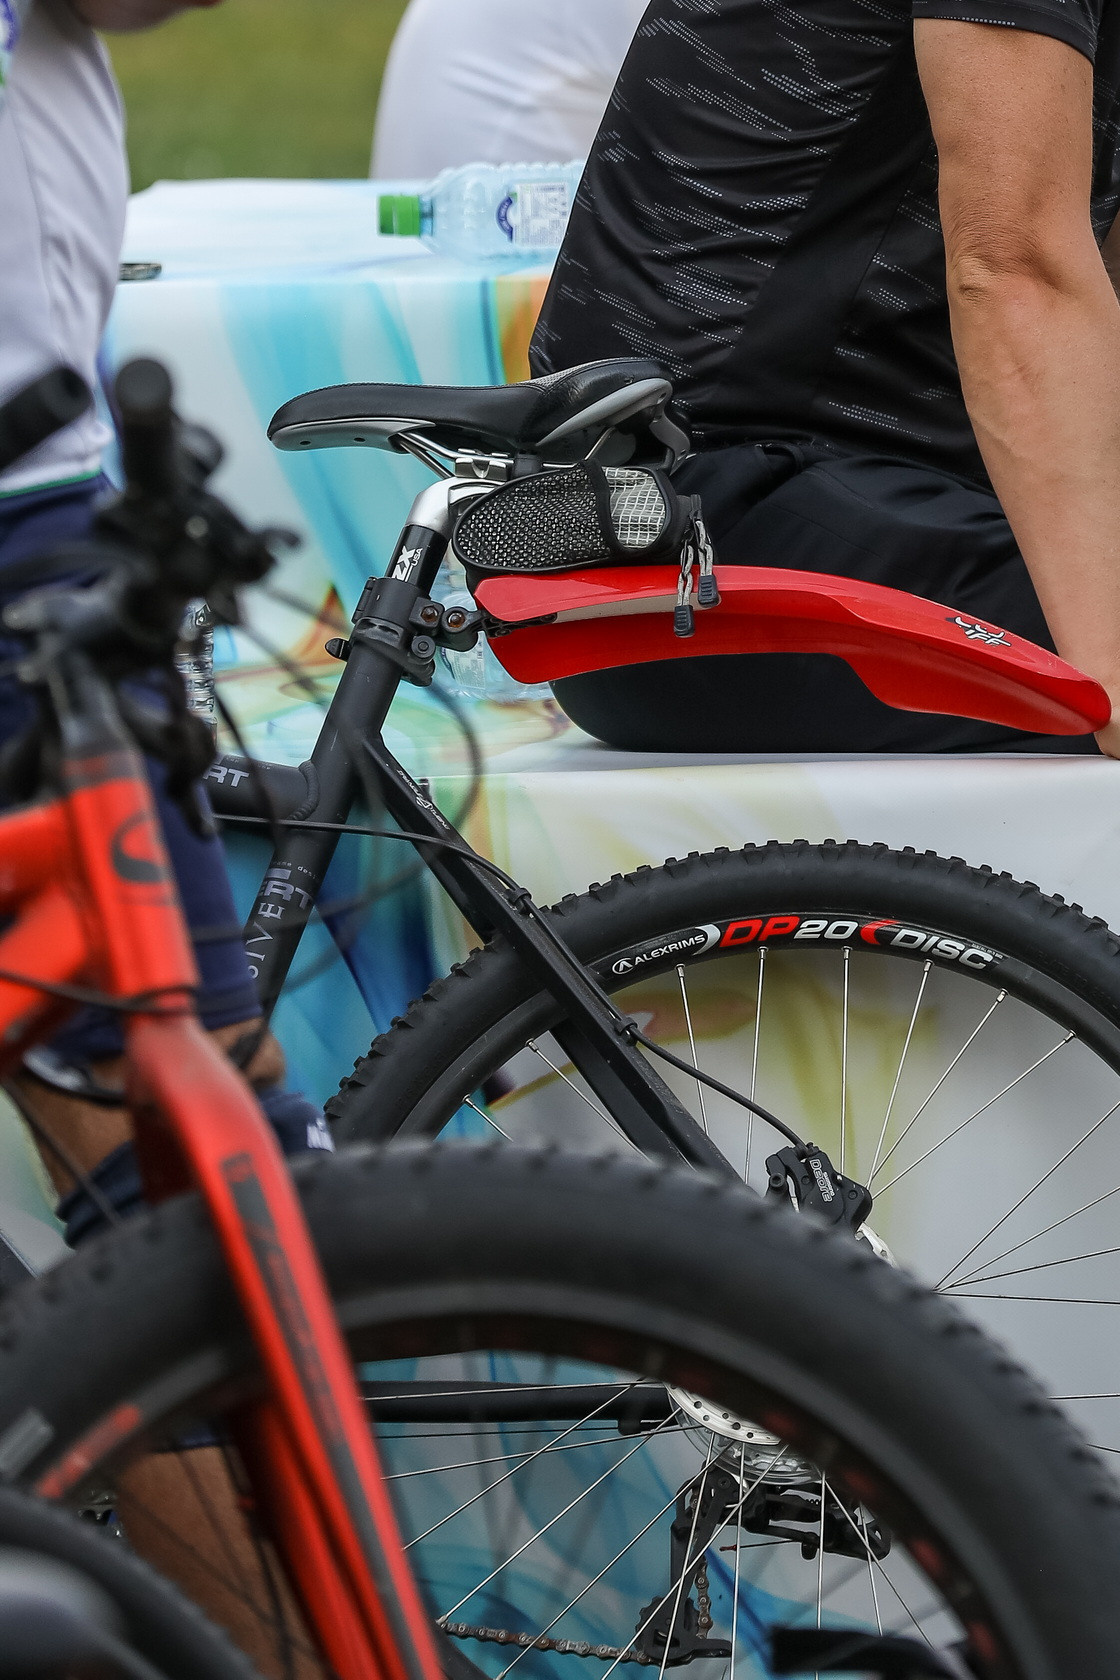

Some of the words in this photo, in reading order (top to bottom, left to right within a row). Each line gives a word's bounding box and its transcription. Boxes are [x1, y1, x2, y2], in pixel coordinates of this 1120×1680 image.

[634, 934, 706, 966] ALEXRIMS
[890, 928, 994, 970] DISC
[810, 1158, 833, 1202] Deore
